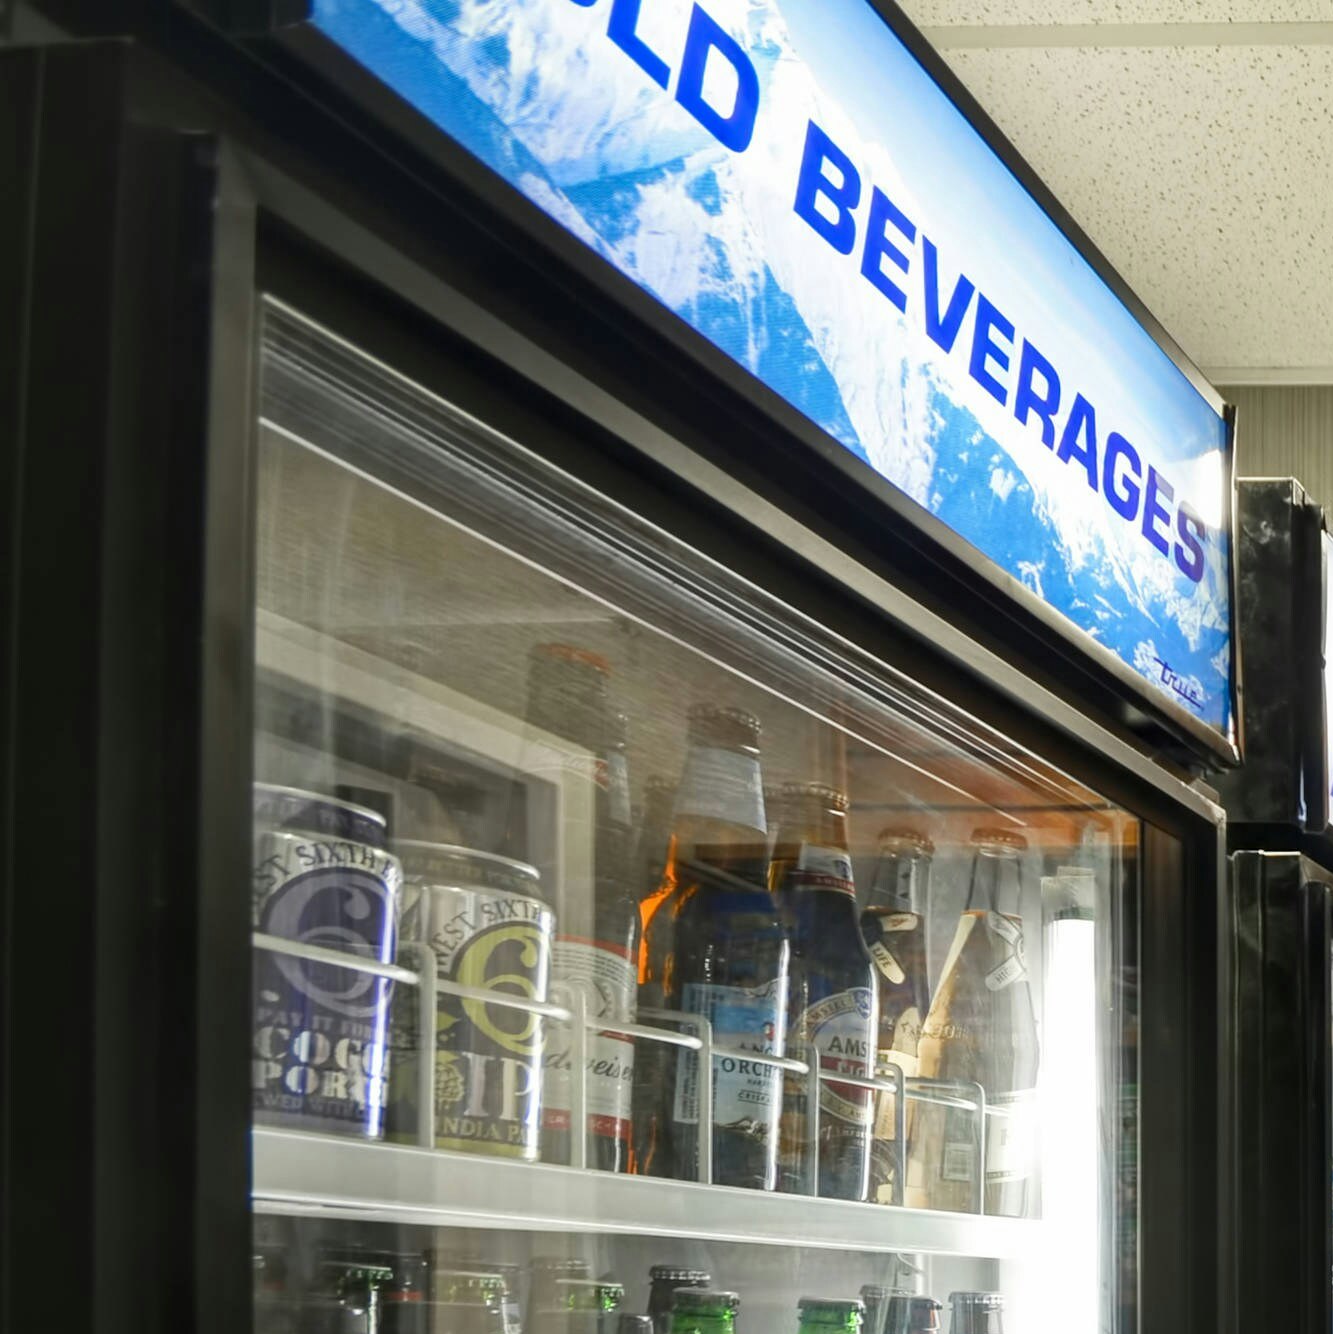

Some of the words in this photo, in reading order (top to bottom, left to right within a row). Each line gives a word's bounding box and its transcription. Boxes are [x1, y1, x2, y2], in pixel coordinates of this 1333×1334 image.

[794, 118, 1206, 584] BEVERAGES
[1155, 658, 1204, 708] true
[870, 945, 893, 971] LIFE
